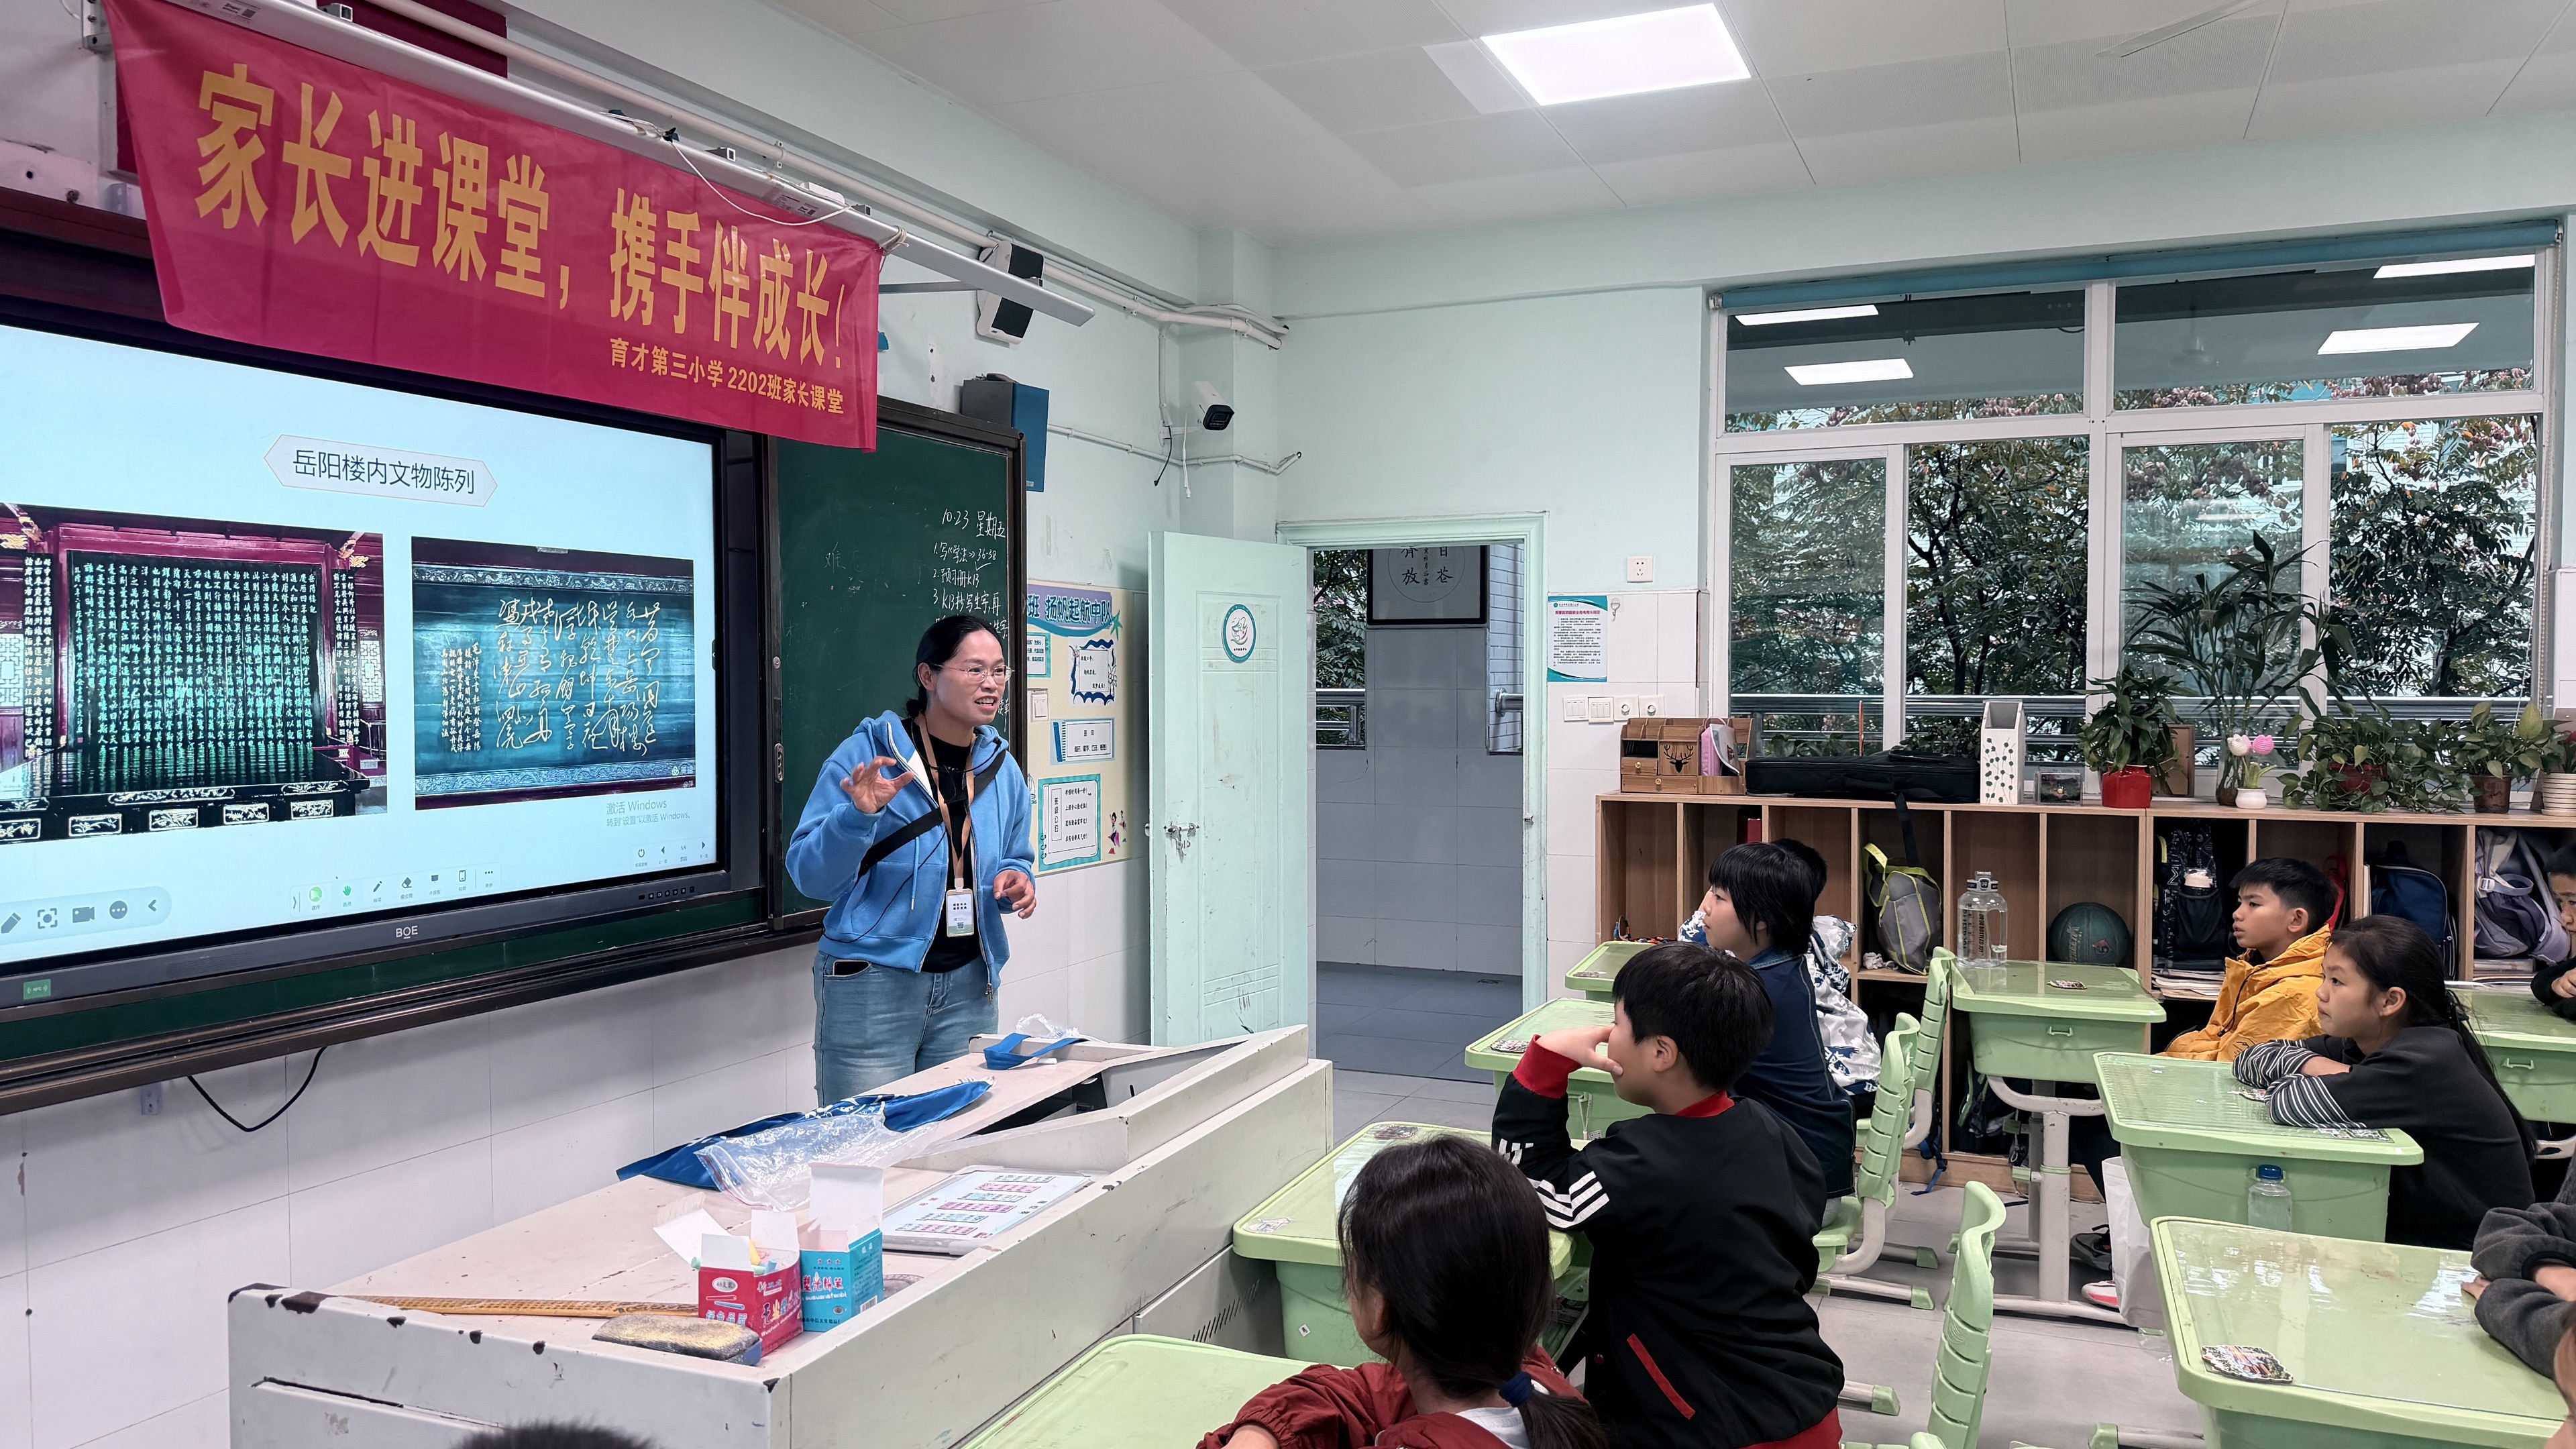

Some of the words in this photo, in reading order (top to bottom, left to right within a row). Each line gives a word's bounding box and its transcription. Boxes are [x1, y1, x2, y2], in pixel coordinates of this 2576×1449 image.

[292, 449, 475, 494] 岳阳楼内文物陈列
[976, 511, 1006, 539] 星期五
[1044, 596, 1112, 625] 扬帆起航中队
[606, 802, 626, 814] 激活
[628, 800, 667, 812] Windows
[396, 926, 418, 938] BOE
